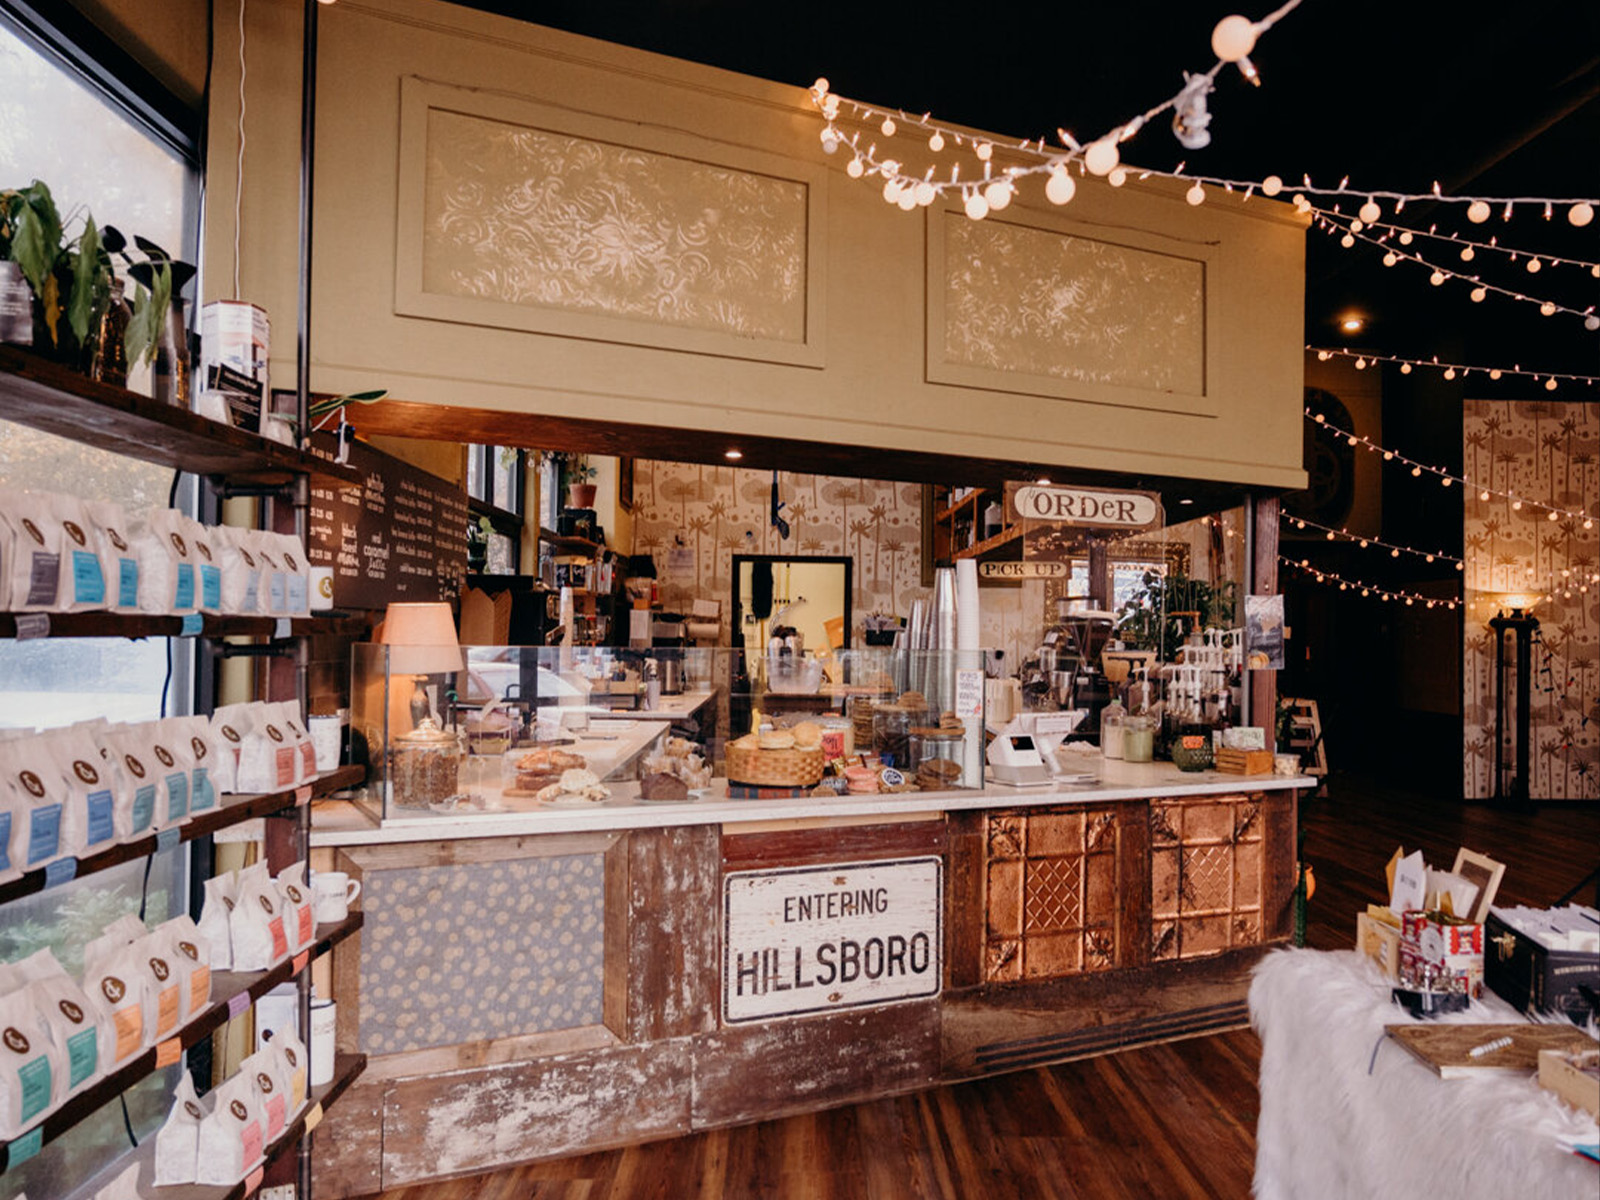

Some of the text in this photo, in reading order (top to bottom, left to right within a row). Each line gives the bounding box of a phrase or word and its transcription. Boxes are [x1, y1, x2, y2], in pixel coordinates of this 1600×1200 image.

[1034, 563, 1061, 576] UP
[784, 887, 888, 923] ENTERING
[736, 931, 929, 997] HILLSBORO
